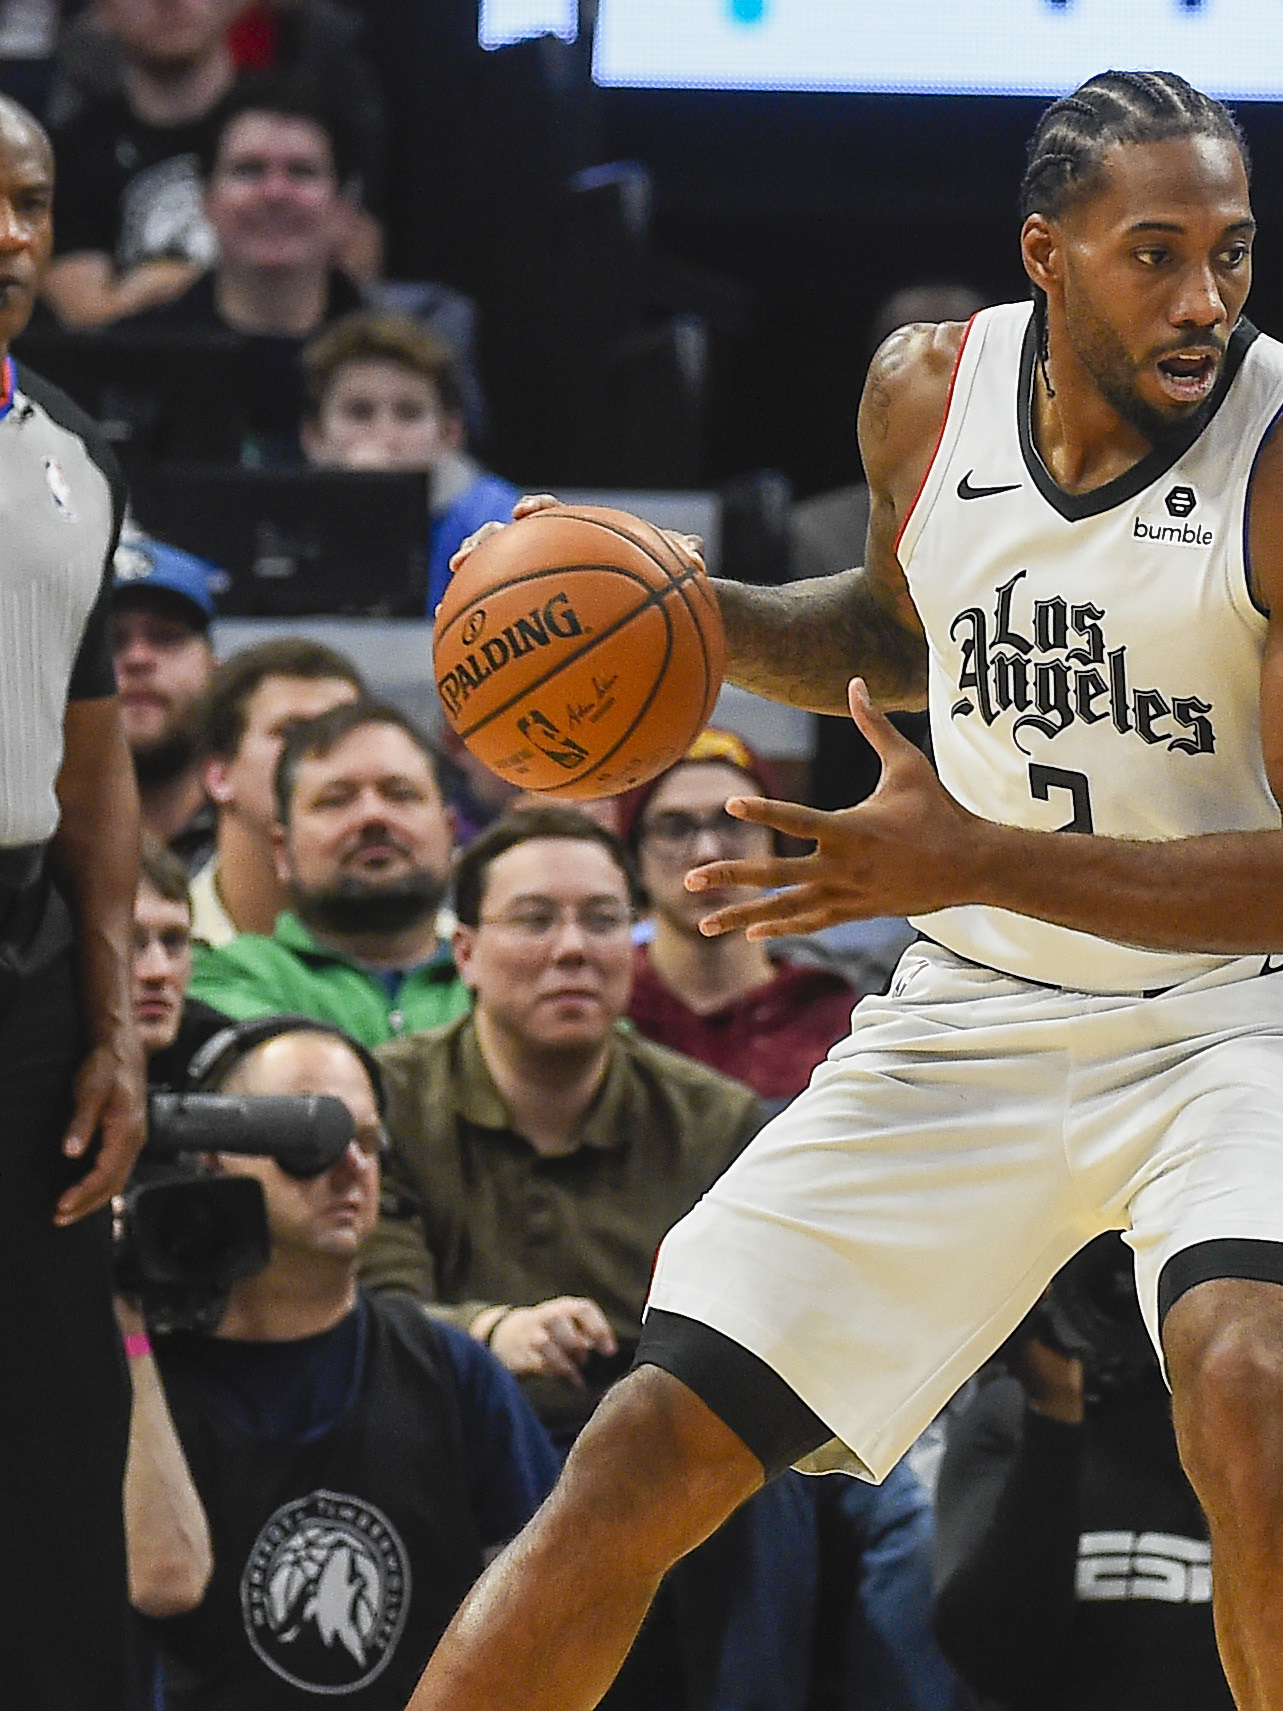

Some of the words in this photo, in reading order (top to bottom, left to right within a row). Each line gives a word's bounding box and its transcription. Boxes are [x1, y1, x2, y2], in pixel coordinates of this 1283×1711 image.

[1133, 516, 1213, 546] bumble
[989, 569, 1106, 666] Los
[950, 607, 1216, 756] Angeles
